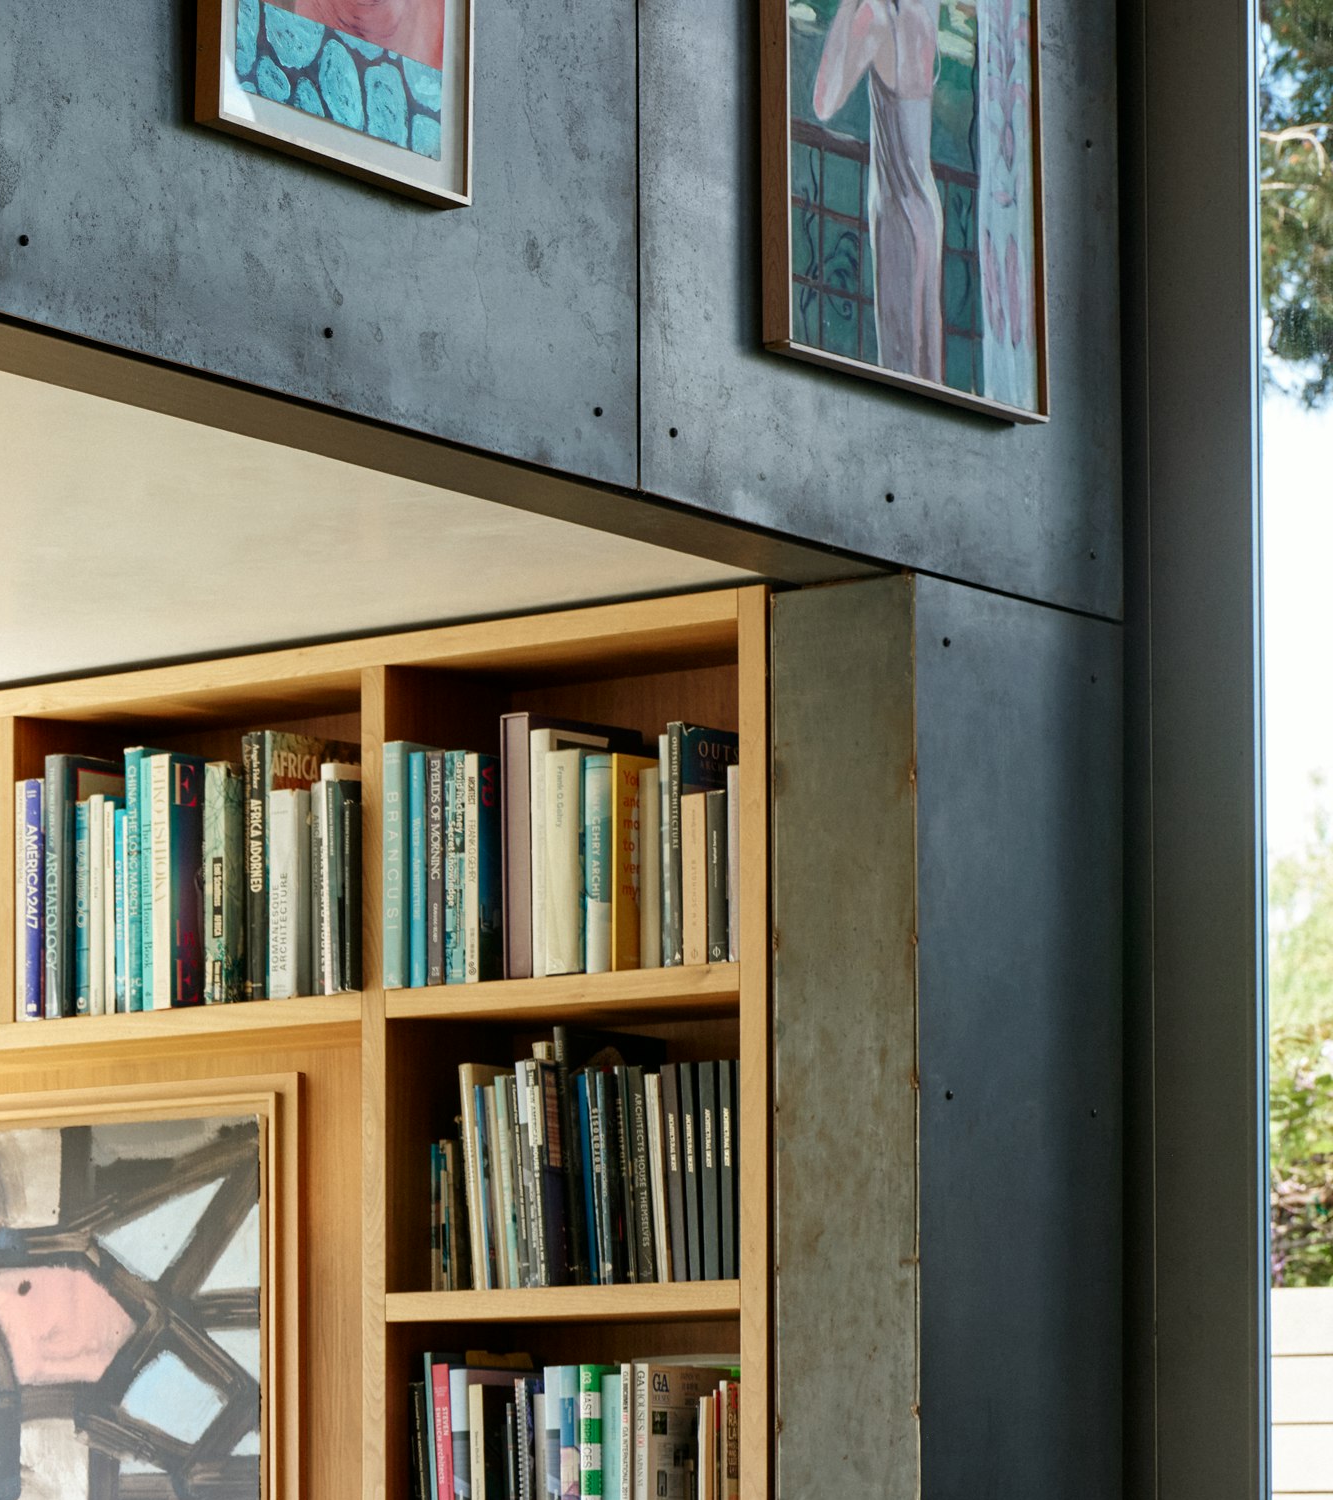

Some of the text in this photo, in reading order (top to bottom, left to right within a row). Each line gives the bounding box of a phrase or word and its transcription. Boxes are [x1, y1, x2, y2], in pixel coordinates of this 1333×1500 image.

[273, 750, 319, 781] AFRICA
[453, 760, 464, 834] david hockney
[468, 776, 476, 804] ARCHITECT
[555, 765, 565, 828] Frank Gehry
[153, 763, 168, 904] EIKO ISHIOKA
[250, 799, 263, 893] AFRICA ADORNED
[430, 760, 441, 881] EYELIDS OF MORNING
[447, 820, 456, 850] Secret
[468, 819, 476, 845] FRANK
[591, 816, 601, 856] GEHRY
[129, 807, 139, 915] THE LONG MARCH
[143, 820, 153, 969] The Essential House Book
[386, 792, 399, 929] BRANCUSI
[45, 851, 58, 970] ARCHAEOLOGY
[271, 884, 279, 973] ROMANESQUE
[279, 872, 288, 972] ARCHITECTURE
[634, 1093, 650, 1247] ARCHITECTS HOUSE THEMSELVES
[636, 1370, 645, 1387] GA
[636, 1388, 645, 1431] HOUSES
[653, 1373, 669, 1393] GA
[436, 1442, 444, 1485] architects
[583, 1389, 592, 1469] MASTERPIECES
